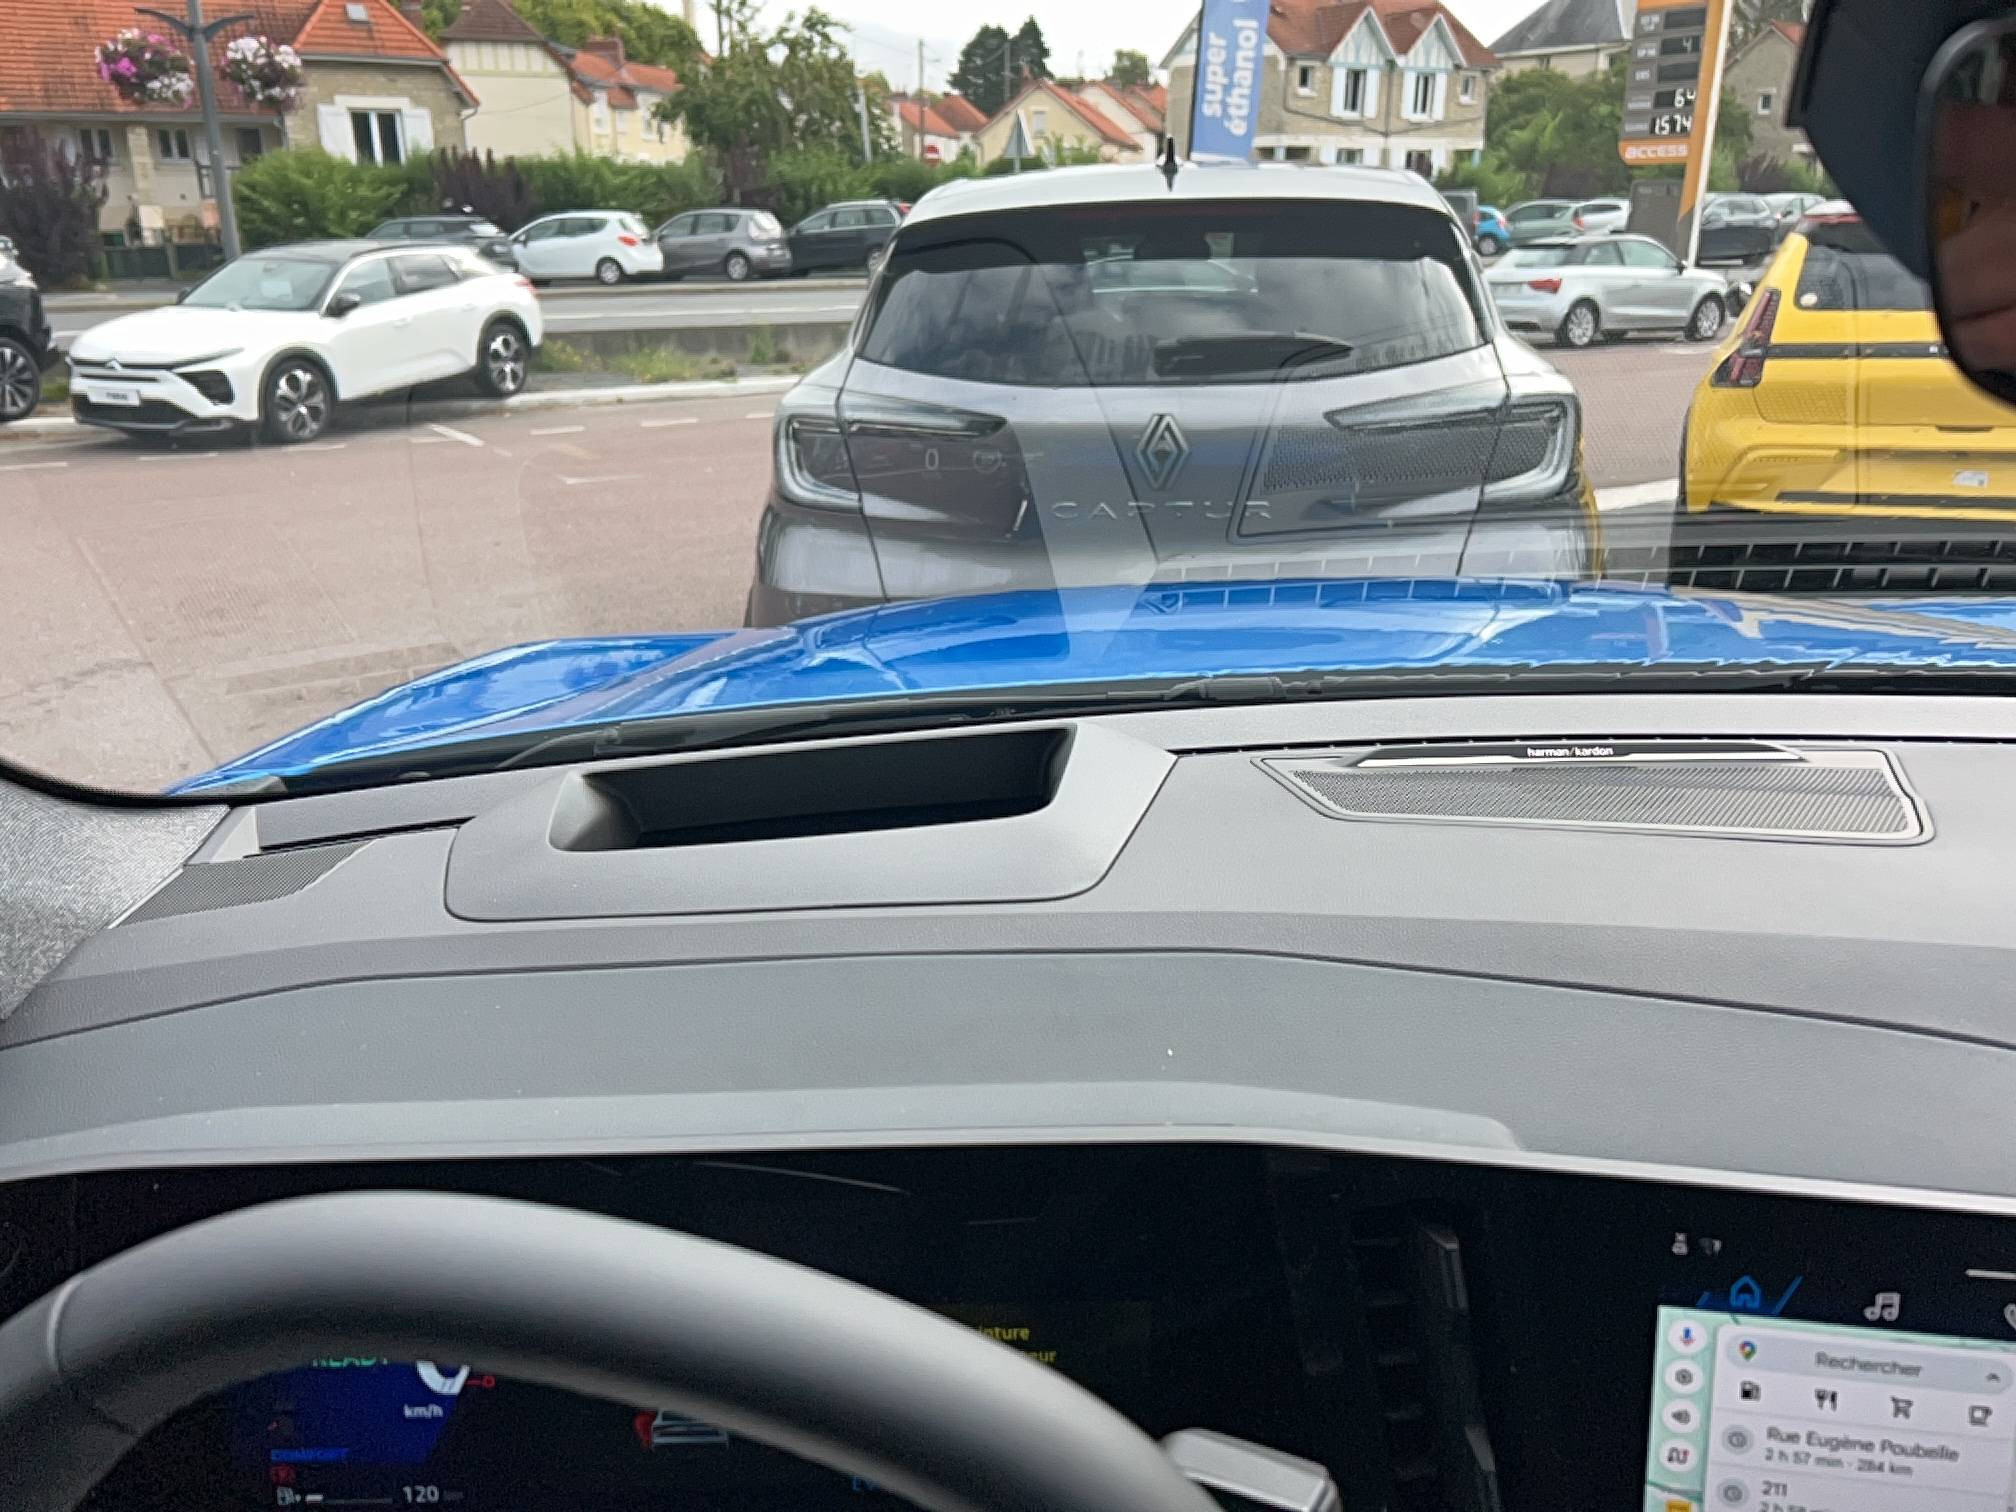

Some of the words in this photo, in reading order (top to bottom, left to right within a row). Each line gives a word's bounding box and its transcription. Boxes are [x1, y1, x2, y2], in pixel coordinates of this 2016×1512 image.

[1203, 32, 1229, 117] super
[1224, 18, 1260, 136] éthanol
[1052, 501, 1273, 520] CAPTUR
[1526, 745, 1614, 758] harman/kardon
[1815, 1351, 1922, 1378] Rechercher
[403, 1403, 443, 1419] km/h
[1766, 1427, 1800, 1443] Rue
[1806, 1431, 1874, 1453] Eugène
[1880, 1438, 1960, 1463] Poubelle
[1889, 1462, 1914, 1478] km
[402, 1485, 440, 1504] 120
